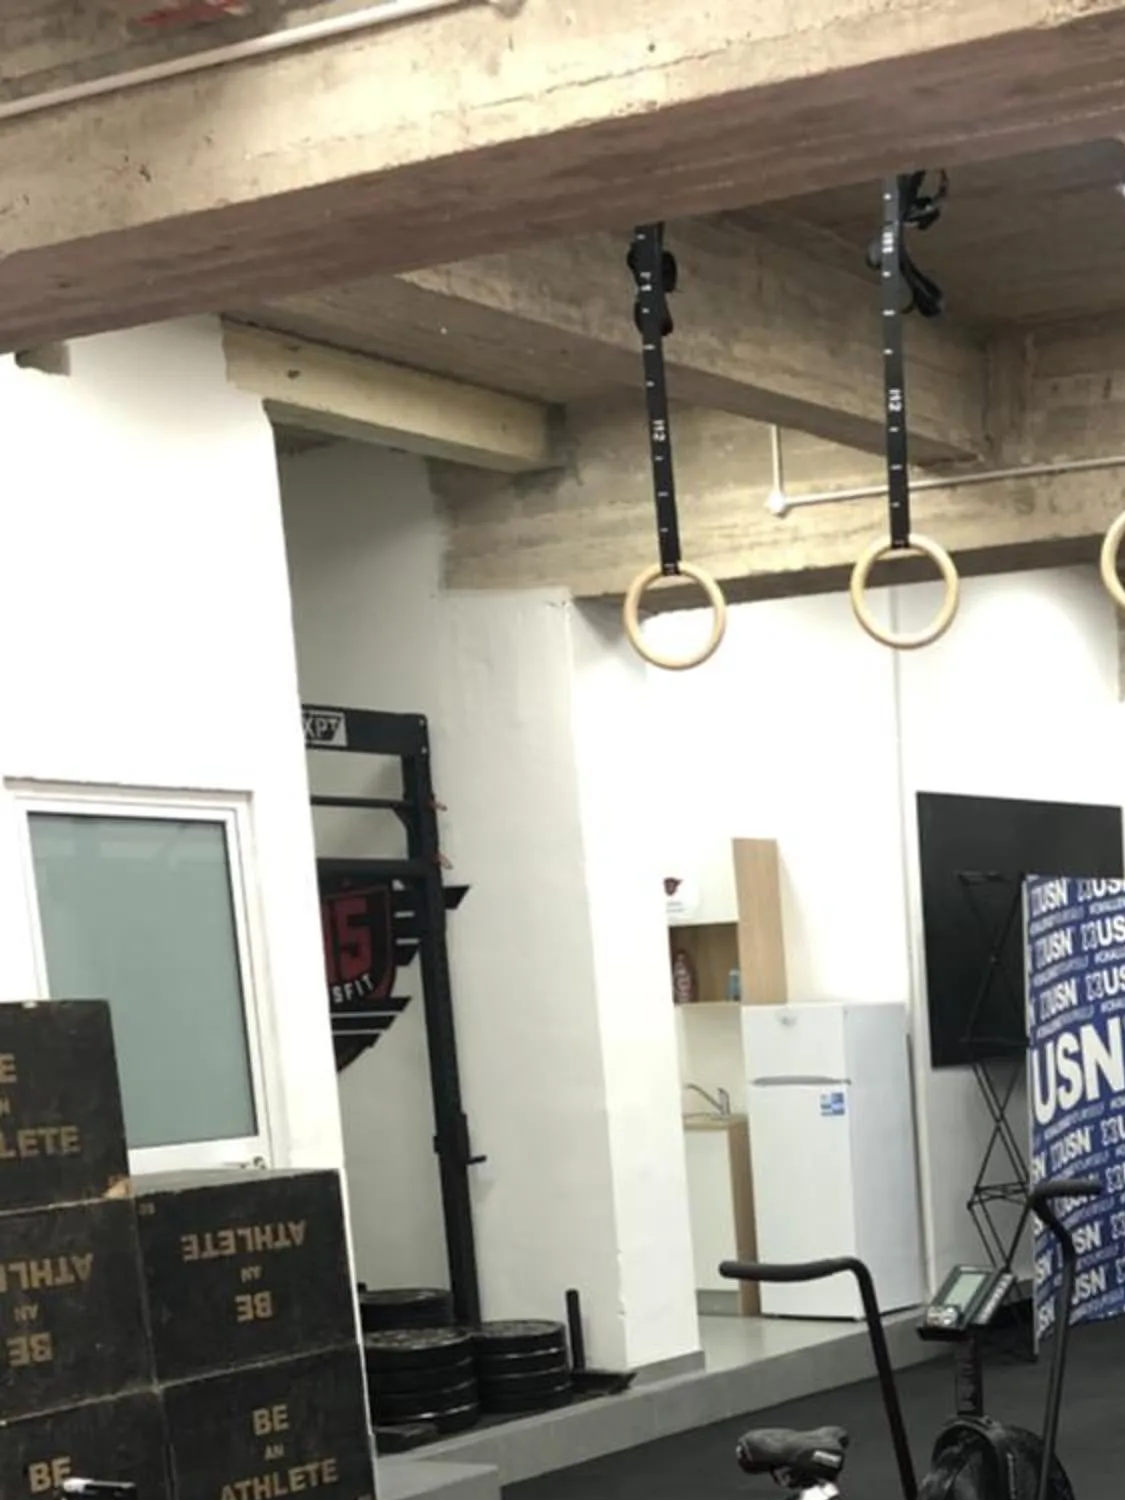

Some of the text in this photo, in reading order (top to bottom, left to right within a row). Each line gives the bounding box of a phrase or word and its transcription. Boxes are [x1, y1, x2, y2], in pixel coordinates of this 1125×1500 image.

[1032, 1017, 1125, 1124] USN
[181, 1220, 305, 1262] ATHLETE
[235, 1291, 272, 1322] BE
[7, 1333, 53, 1367] BE
[253, 1404, 290, 1436] BE
